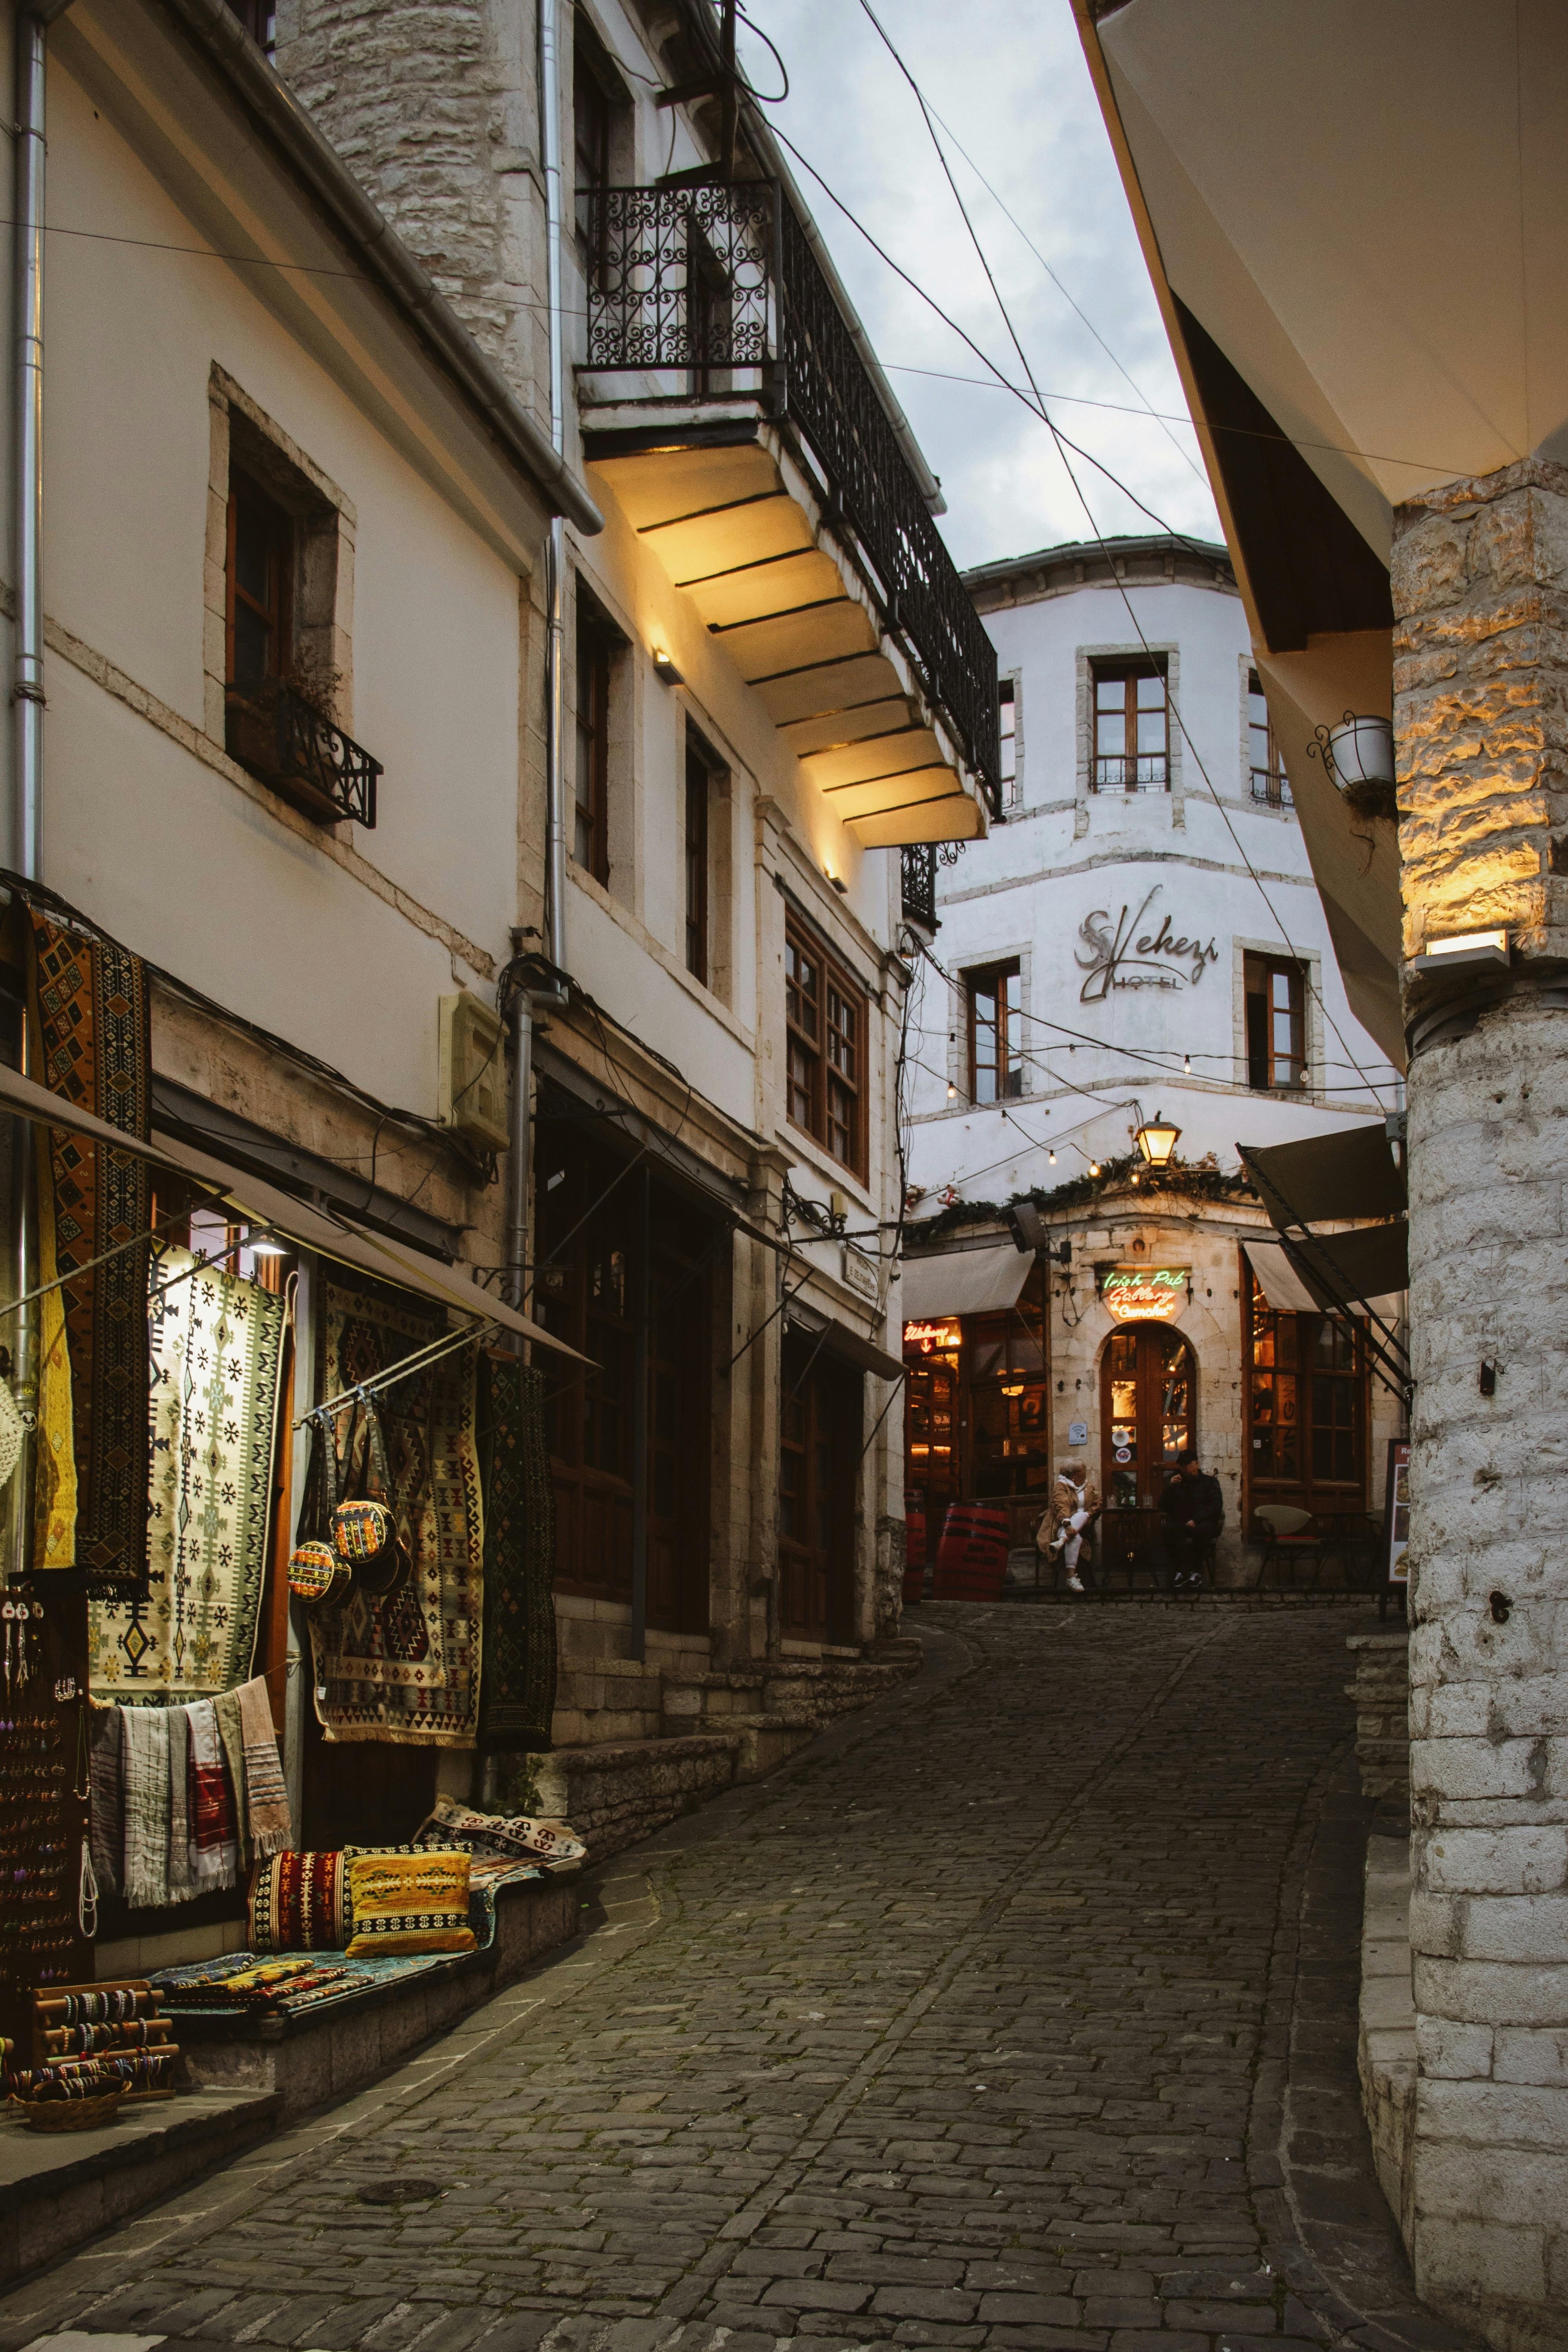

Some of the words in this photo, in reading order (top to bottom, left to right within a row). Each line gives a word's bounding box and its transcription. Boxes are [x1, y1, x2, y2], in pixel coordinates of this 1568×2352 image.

[1112, 975, 1183, 991] HOTEL
[1104, 1272, 1143, 1289] Irish
[1151, 1270, 1185, 1286] Pub
[1110, 1286, 1176, 1305] Gallery
